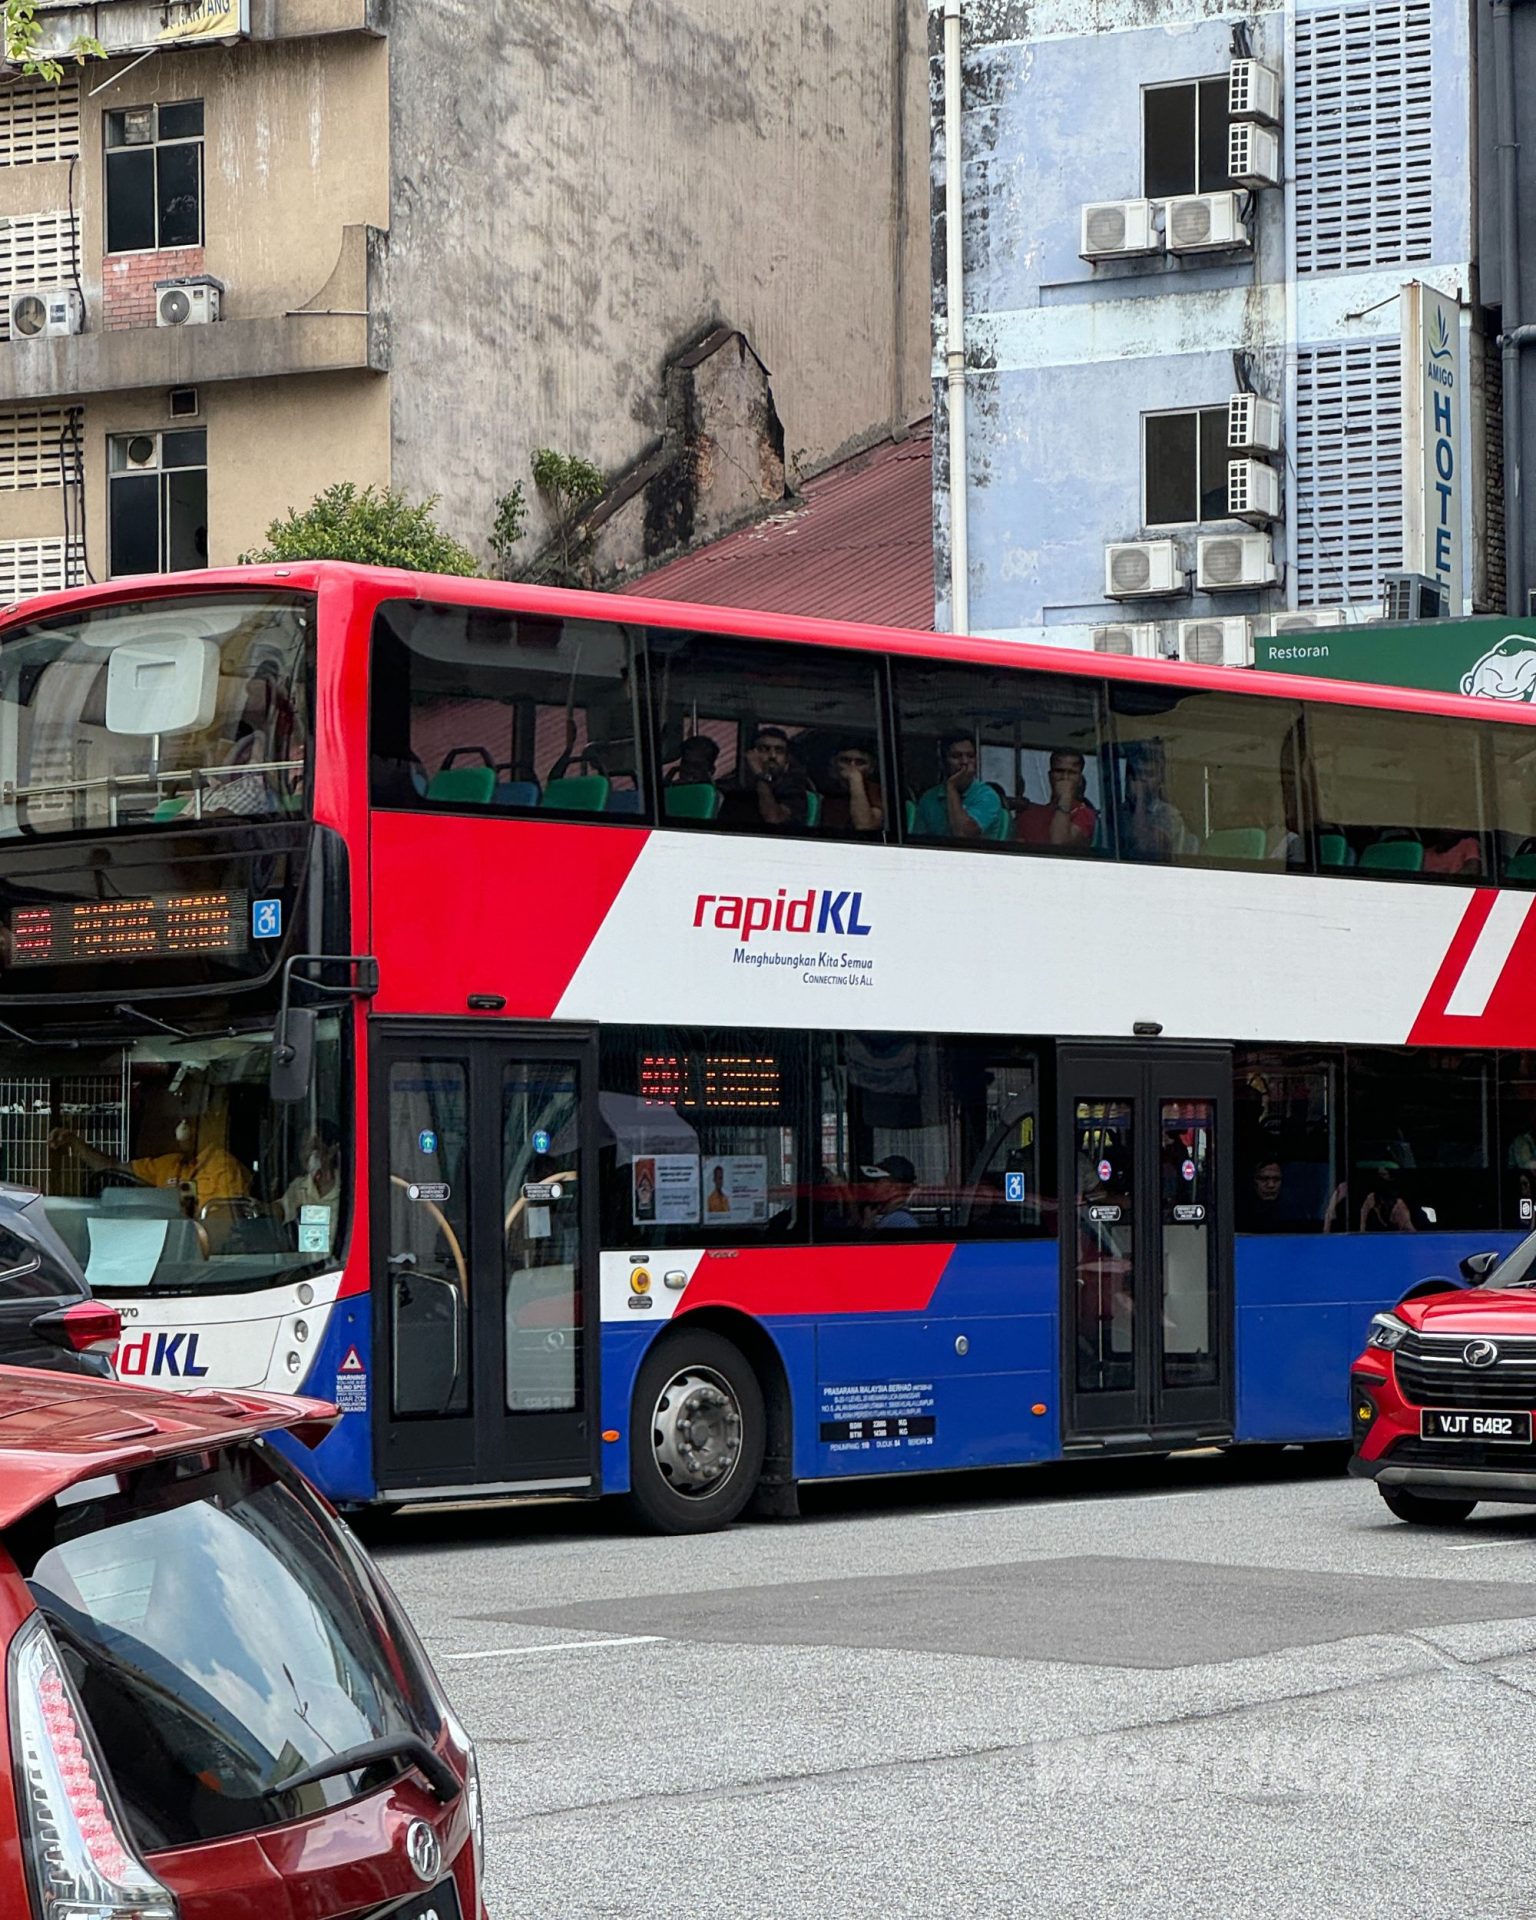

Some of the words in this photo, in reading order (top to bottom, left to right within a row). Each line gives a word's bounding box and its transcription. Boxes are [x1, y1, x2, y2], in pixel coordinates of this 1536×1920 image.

[1428, 361, 1454, 388] AMIGO
[1433, 389, 1454, 585] HOTE
[1268, 645, 1329, 660] Restoran
[693, 888, 872, 942] rapidKL
[733, 948, 816, 968] Menghubungkan
[818, 952, 839, 967] Kita
[840, 953, 873, 969] Semua
[1440, 1415, 1469, 1433] VJT
[1472, 1417, 1513, 1434] 6482
